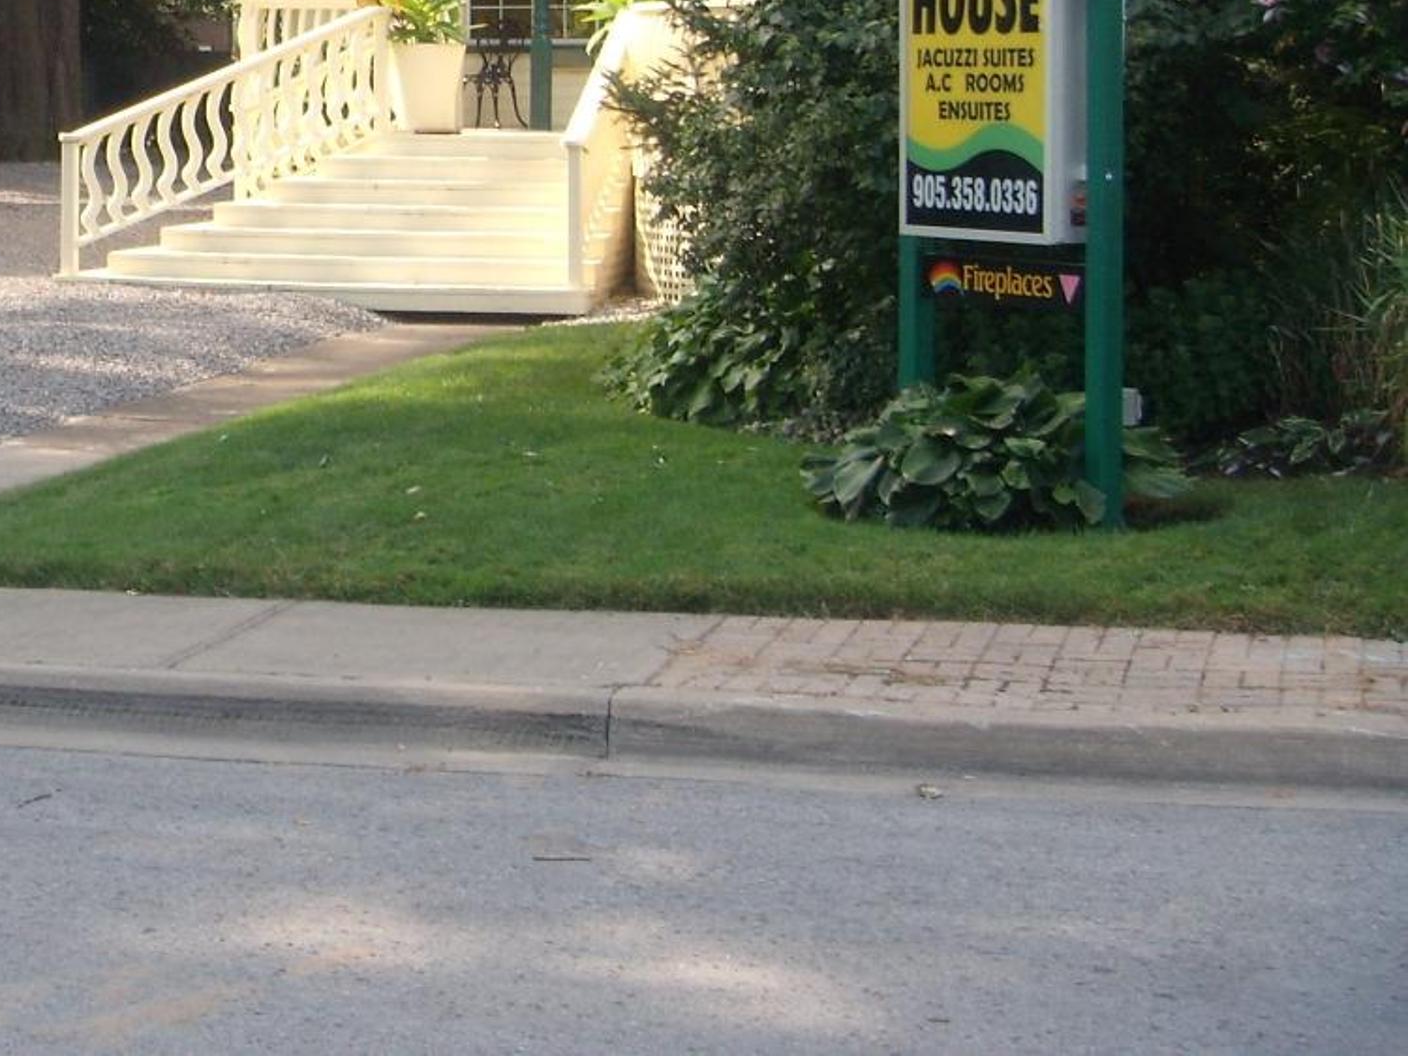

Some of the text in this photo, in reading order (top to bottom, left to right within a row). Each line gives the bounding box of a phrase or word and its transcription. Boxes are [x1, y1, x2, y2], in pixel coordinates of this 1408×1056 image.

[917, 48, 1034, 68] JACUZZI SUITES
[965, 73, 1024, 93] ROOMS
[938, 101, 1011, 121] ENSUITES
[912, 174, 1038, 215] 905.358.0336
[962, 265, 1053, 300] Fireplaces
